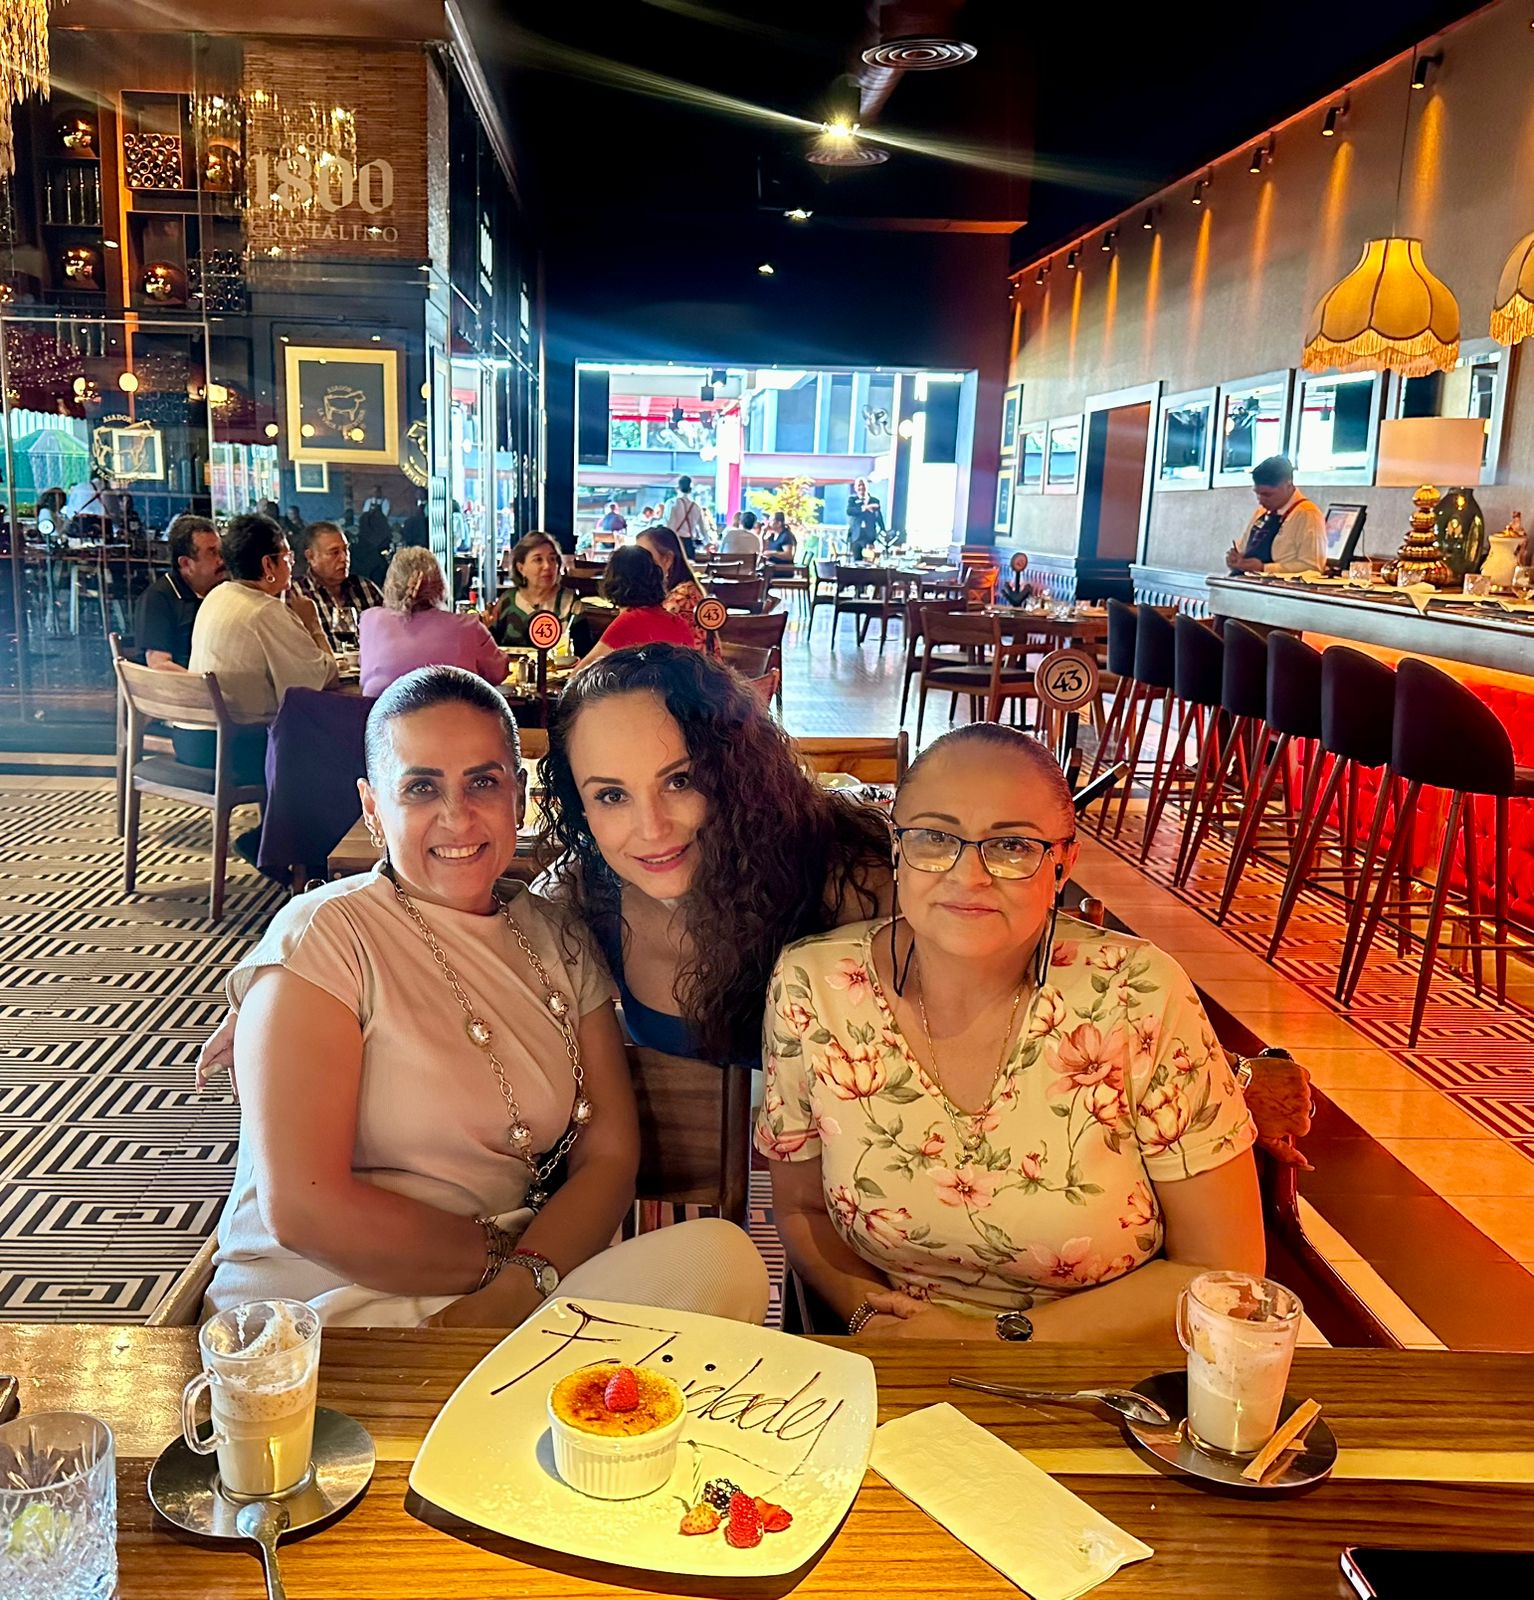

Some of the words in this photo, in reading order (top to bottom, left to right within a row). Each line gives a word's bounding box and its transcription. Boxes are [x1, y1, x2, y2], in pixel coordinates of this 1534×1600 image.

[288, 132, 353, 149] TEQUIA
[250, 151, 394, 215] 1800
[249, 221, 399, 243] CRISTALINO
[702, 608, 719, 621] 43
[535, 623, 554, 639] 43
[1052, 669, 1083, 693] 43
